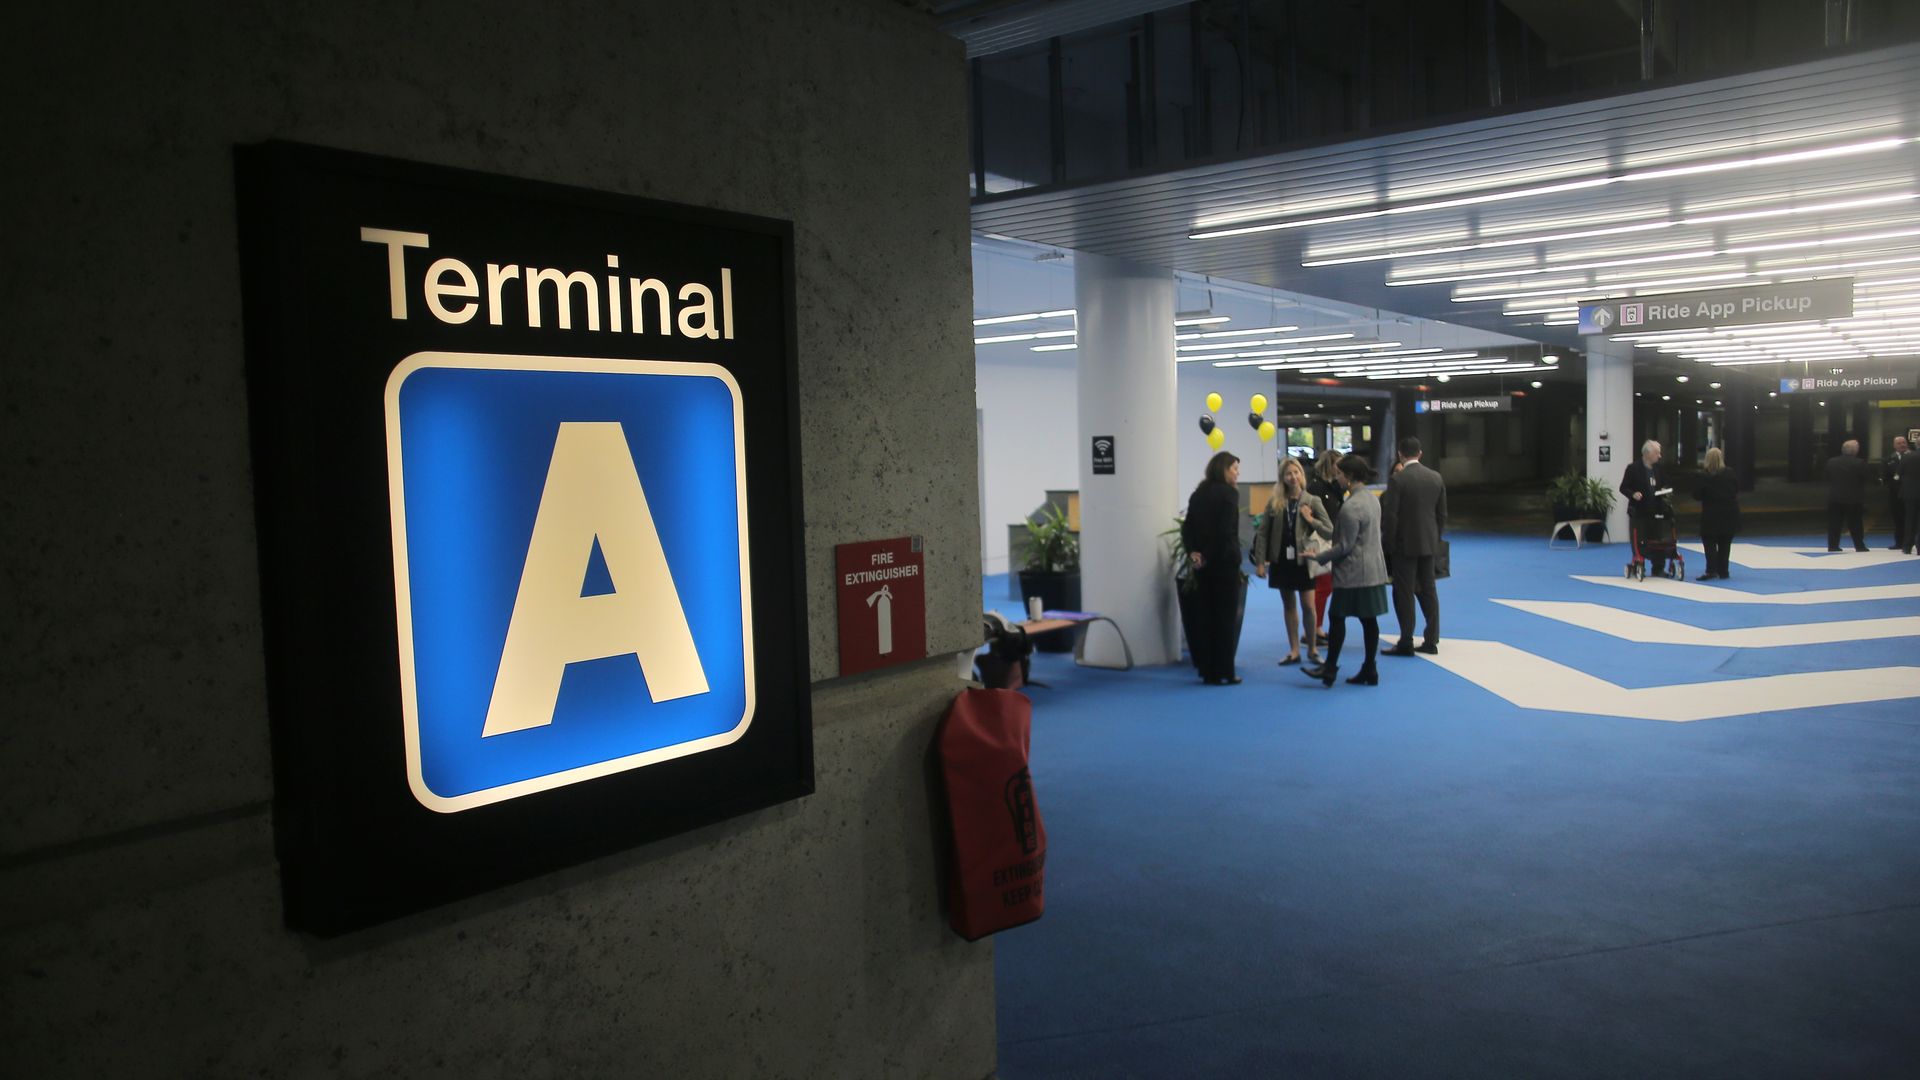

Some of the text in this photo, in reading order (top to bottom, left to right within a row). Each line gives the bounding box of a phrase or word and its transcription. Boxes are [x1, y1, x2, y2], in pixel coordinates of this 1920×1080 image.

[360, 226, 734, 340] Terminal
[1648, 296, 1812, 321] Ride App Pickup
[1816, 377, 1898, 388] Ride App Pickup
[1441, 400, 1499, 410] Ride App Pickup
[871, 552, 894, 566] FIRE
[480, 420, 711, 739] A
[845, 565, 919, 586] EXTINGUISHER
[1002, 885, 1032, 908] KEEP
